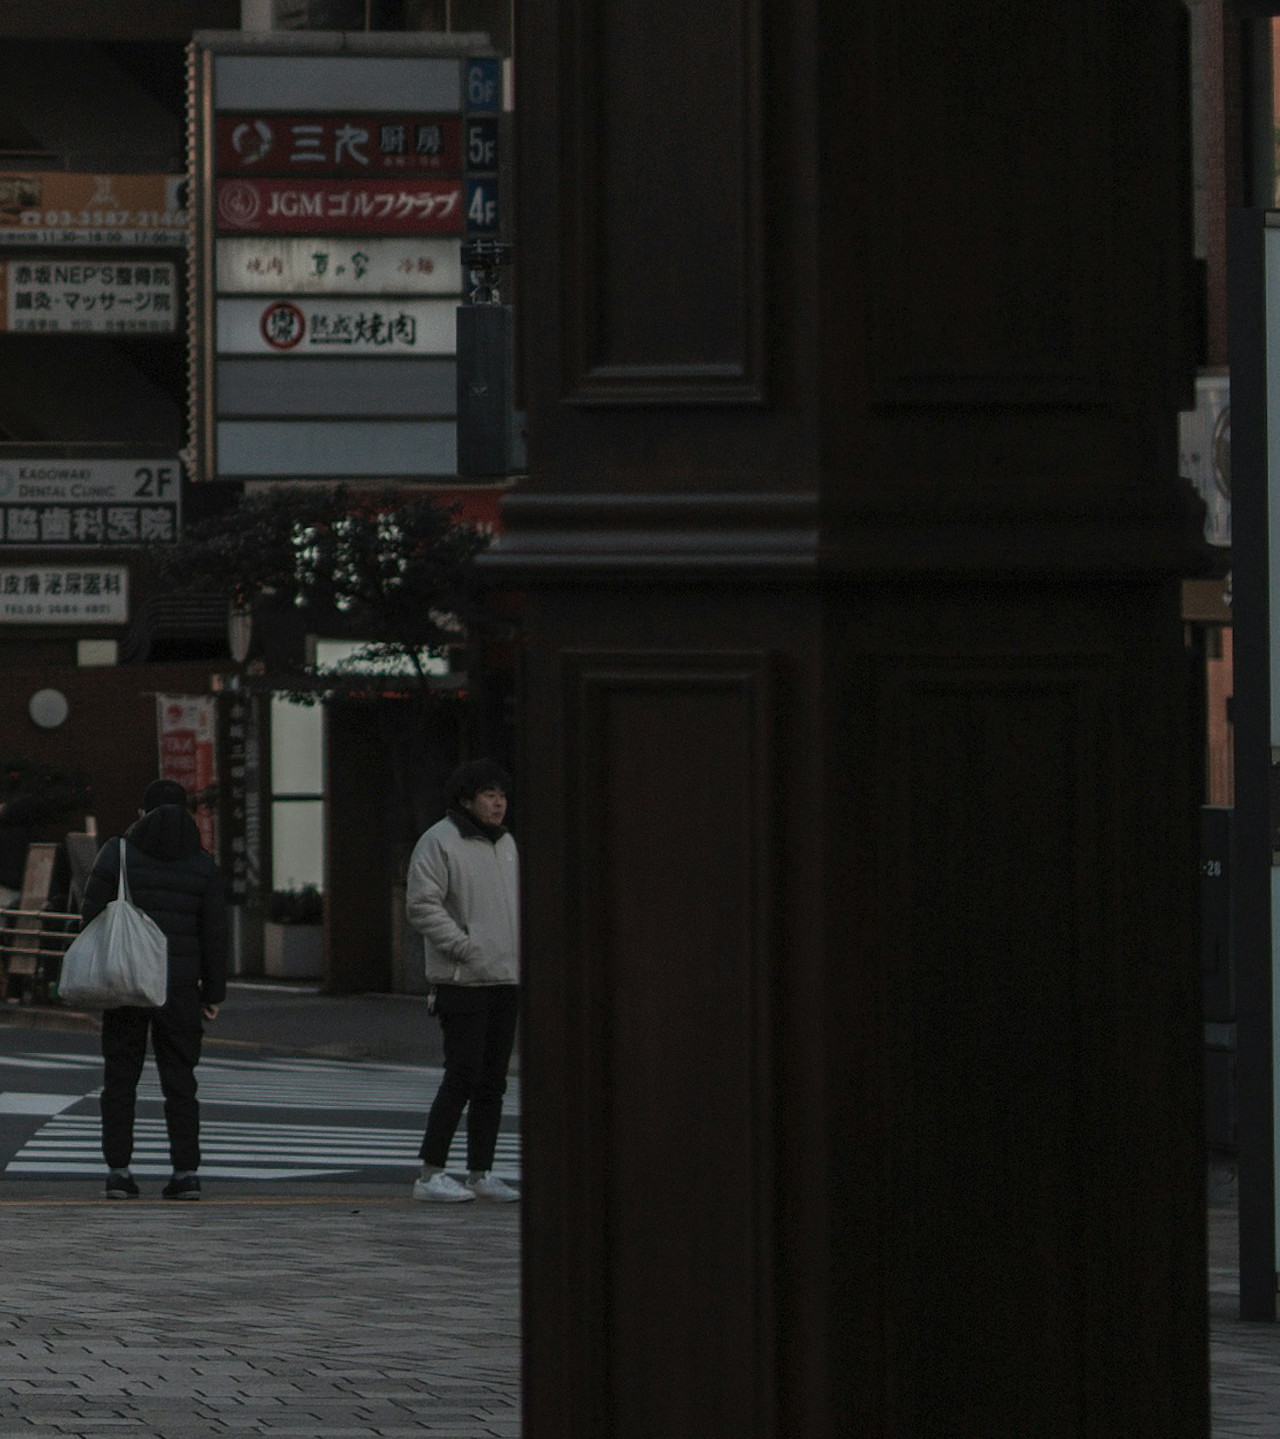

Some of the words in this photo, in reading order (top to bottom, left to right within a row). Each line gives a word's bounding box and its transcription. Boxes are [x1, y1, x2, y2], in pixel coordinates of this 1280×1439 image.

[468, 66, 493, 104] 6F
[468, 125, 495, 164] 5F
[468, 185, 496, 225] 4F
[134, 467, 173, 497] 2F
